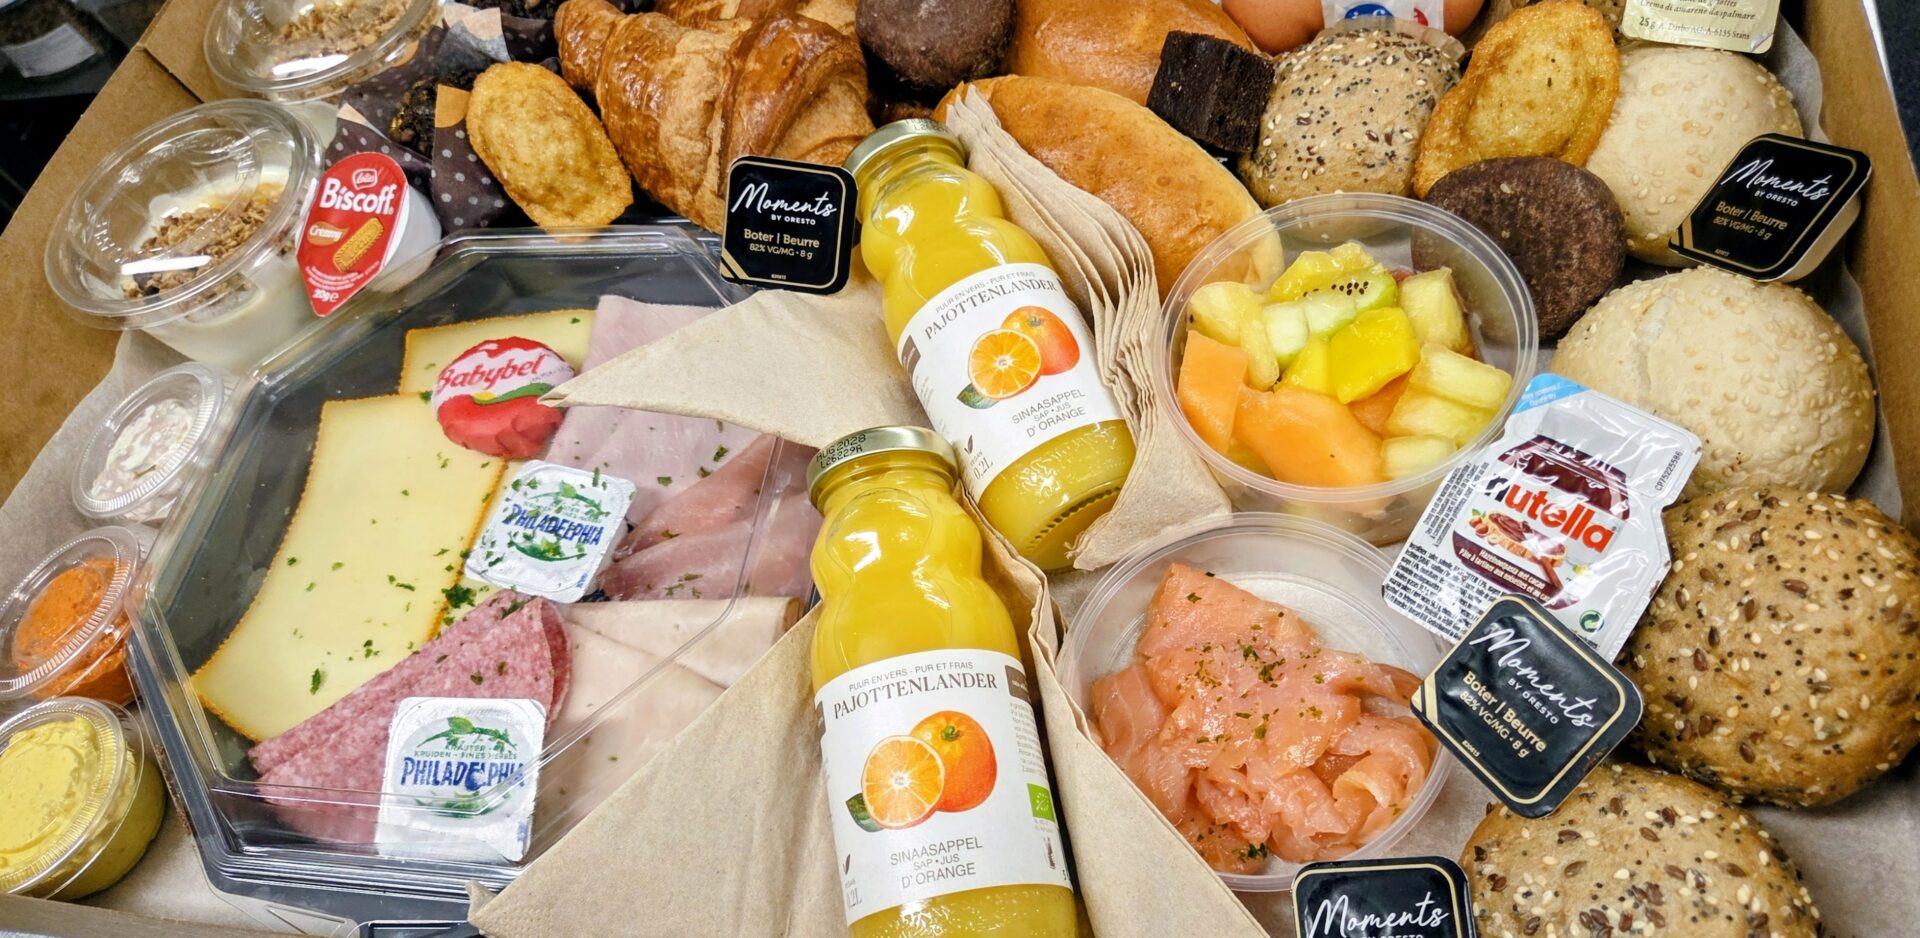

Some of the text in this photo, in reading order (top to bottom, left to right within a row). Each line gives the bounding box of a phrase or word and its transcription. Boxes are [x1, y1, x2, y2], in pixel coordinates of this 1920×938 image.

[1639, 16, 1649, 27] 25
[1665, 3, 1672, 11] di
[1721, 158, 1832, 201] Moments
[320, 178, 397, 215] Biscoff
[731, 182, 837, 217] Moments
[1766, 192, 1799, 207] ORESTO
[784, 216, 816, 225] ORESTO
[1715, 200, 1744, 218] Boter
[1750, 210, 1788, 231] Beurre
[309, 225, 343, 242] Creamy
[744, 229, 774, 242] Boter
[783, 234, 820, 248] Beurre
[750, 243, 766, 252] 82%
[767, 246, 795, 256] VG/MG
[936, 297, 954, 313] PUUR
[955, 291, 965, 300] EN
[966, 283, 985, 296] VERS
[990, 274, 1005, 284] PUR
[924, 279, 1057, 340] PAJOTTENLANDER
[436, 353, 548, 396] Babybel
[1012, 388, 1086, 425] SINAASAPPEL
[1034, 402, 1072, 421] SAP JUS
[1038, 406, 1086, 431] ORANGE
[816, 434, 866, 462] AUG 2028
[502, 504, 604, 545] PHILADELPHIA
[1484, 474, 1616, 553] nutella
[1517, 570, 1529, 581] met
[1527, 575, 1546, 589] cacao
[849, 678, 870, 691] PUUR
[872, 674, 883, 684] EN
[883, 668, 908, 682] VERS
[915, 664, 934, 674] PUR
[936, 663, 947, 671] ET
[949, 661, 973, 670] FRAIS
[1469, 628, 1600, 728] Moments
[833, 672, 998, 719] PAJOTTENLANDER
[1508, 678, 1559, 725] BY ORESTO
[1459, 690, 1479, 711] 82%
[1478, 708, 1509, 739] VG/MG
[1512, 740, 1521, 750] 8
[1462, 671, 1497, 706] Boter
[1502, 709, 1547, 752] Beurre
[890, 836, 983, 866] SINAASAPPEL
[913, 853, 960, 871] SAP JUS
[916, 863, 976, 885] ORANGE
[1309, 891, 1449, 938] Moments
